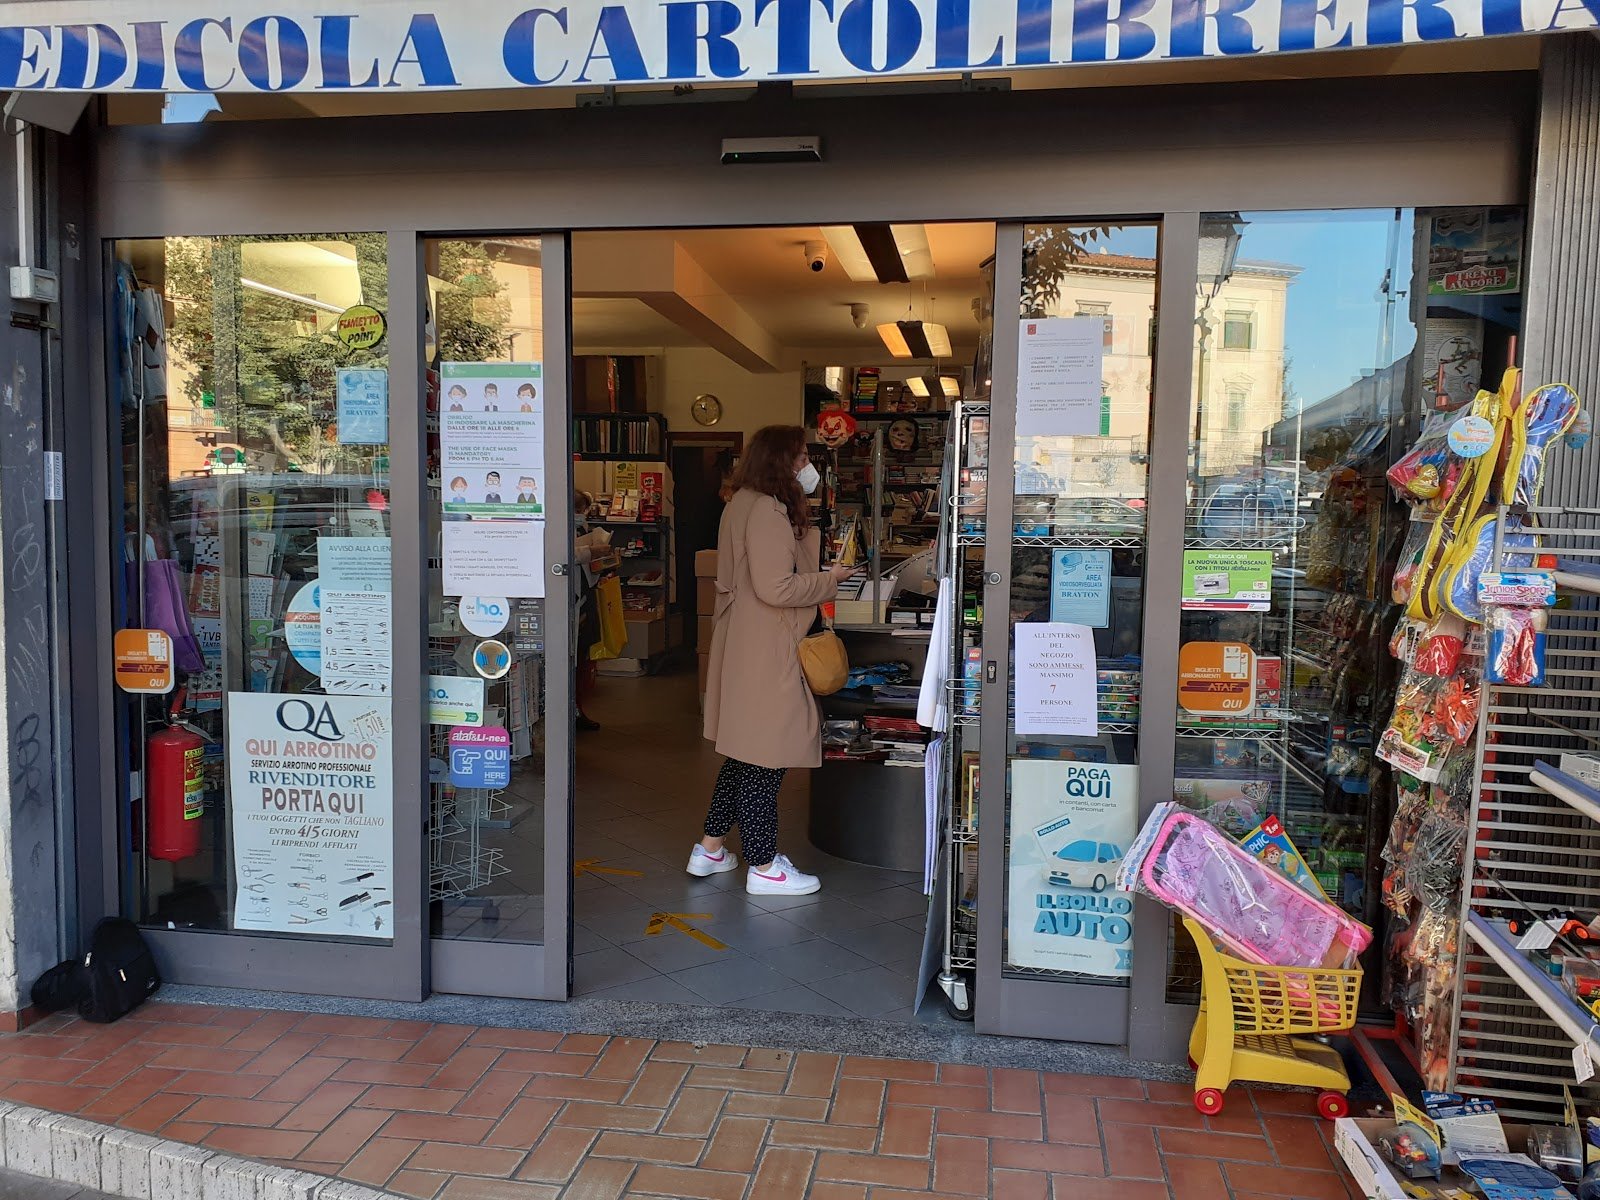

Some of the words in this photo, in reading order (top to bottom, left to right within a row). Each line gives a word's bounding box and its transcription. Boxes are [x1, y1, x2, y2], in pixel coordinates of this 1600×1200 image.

[0, 15, 462, 90] EDICOLA
[339, 315, 380, 329] FUMETTO
[347, 331, 375, 343] POINT
[326, 627, 332, 635] 6
[138, 664, 161, 672] ATAF
[150, 678, 165, 687] QUI
[1050, 684, 1057, 694] 7
[1208, 683, 1239, 692] ATAF
[1222, 699, 1243, 709] QUI
[276, 698, 346, 741] QA
[246, 738, 277, 756] QUI
[283, 741, 377, 760] ARROTINO
[484, 749, 507, 761] QUI
[250, 759, 281, 769] SERVIZIO
[282, 760, 317, 771] ARROTINO
[318, 762, 372, 773] PROFESSIONALE
[248, 770, 376, 789] RIVENDITORE
[484, 772, 507, 780] HERE
[1068, 767, 1111, 780] PAGA
[1066, 778, 1111, 799] QUI
[262, 787, 325, 813] PORTA
[328, 792, 364, 816] QUI
[270, 814, 308, 824] OGGETTI
[344, 816, 385, 827] TAGLIANO
[268, 828, 296, 836] ENTRO
[297, 824, 321, 839] 4/5
[321, 828, 360, 839] GIORNI
[280, 840, 320, 848] RIPRENDI
[322, 842, 358, 850] AFFILATI
[1036, 894, 1056, 909] IL
[1056, 894, 1133, 915] BOLLO
[1034, 910, 1132, 944] AUTO
